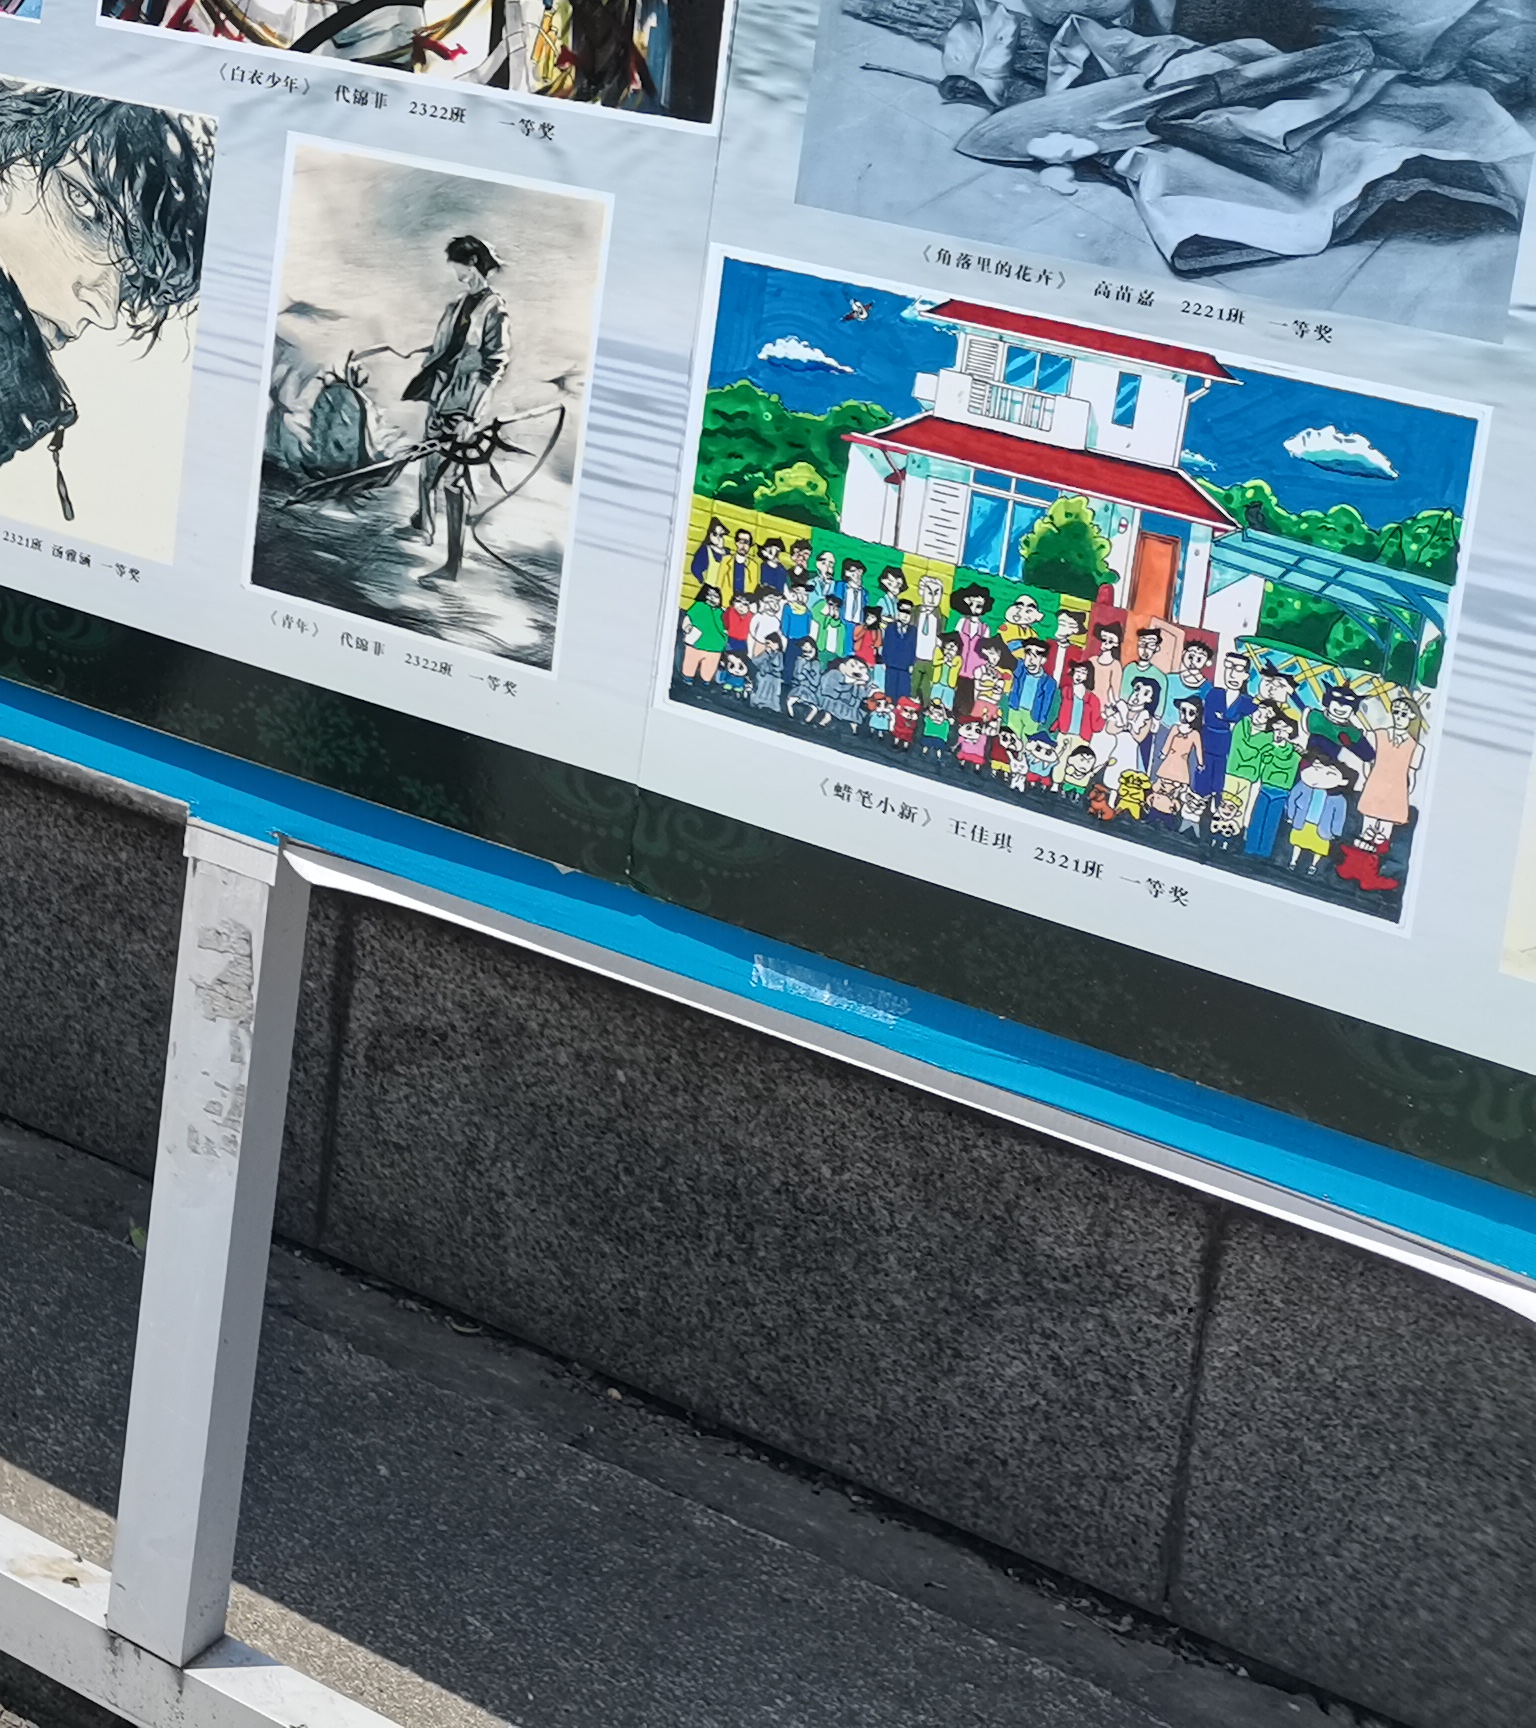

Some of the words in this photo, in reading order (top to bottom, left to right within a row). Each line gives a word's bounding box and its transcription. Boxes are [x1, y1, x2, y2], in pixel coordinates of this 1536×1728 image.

[217, 62, 312, 97] 《白衣少年》
[408, 100, 467, 125] 2322班
[498, 117, 556, 142] 一等奖
[922, 243, 1067, 290] 《角落里的花卉》
[1181, 299, 1247, 326] 2221班
[1267, 317, 1334, 345] 一等奖
[2, 529, 43, 553] 2321班
[99, 562, 141, 583] 一等奖
[269, 609, 320, 638] 《青年》
[404, 652, 454, 677] 2322班
[469, 673, 518, 698] 一等奖
[819, 777, 933, 828] 《蜡笔小新》
[947, 816, 1014, 855] 王佳琪
[1033, 845, 1105, 881] 2321班
[1117, 874, 1191, 908] 一等奖
